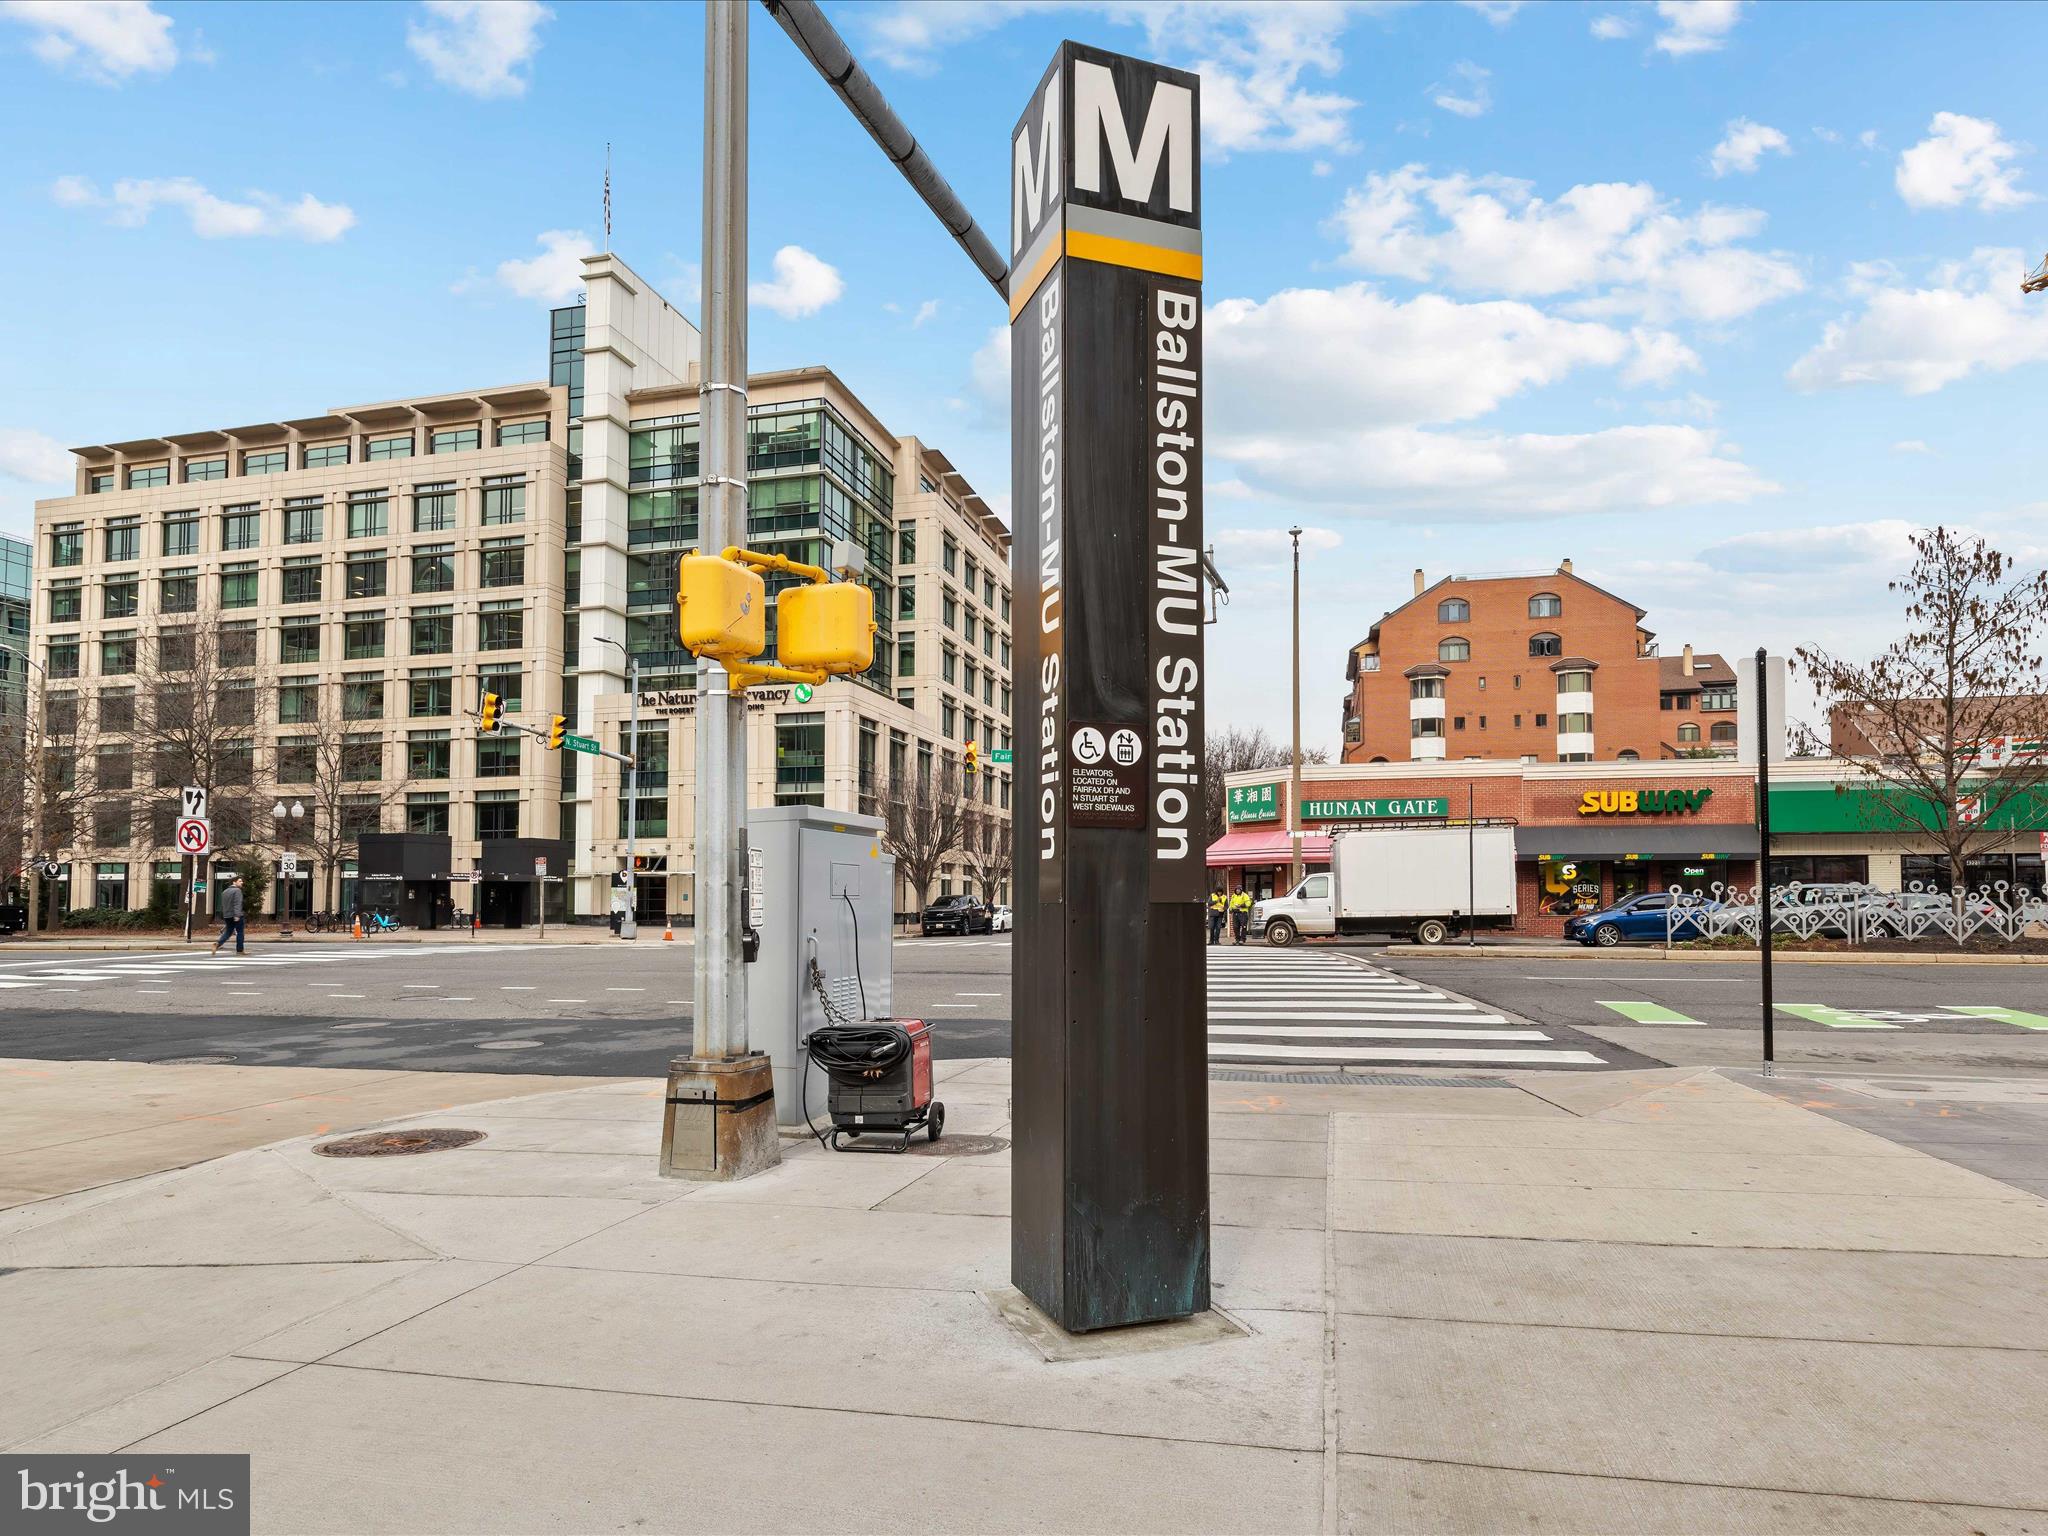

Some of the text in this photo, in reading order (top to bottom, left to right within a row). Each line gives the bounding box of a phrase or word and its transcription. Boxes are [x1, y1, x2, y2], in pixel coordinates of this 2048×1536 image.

[1074, 59, 1192, 213] M
[1013, 66, 1060, 258] M
[1041, 276, 1060, 859] Ballston-MU Station
[1156, 290, 1198, 859] Ballston-MU Station
[637, 692, 656, 707] The
[669, 707, 695, 715] ROBERT
[573, 740, 589, 750] Stuart
[1072, 768, 1114, 777] ELEVATORS
[1072, 777, 1105, 785] LOCATED
[1072, 785, 1102, 794] FAIRFAX
[1115, 787, 1130, 795] AND
[1080, 794, 1108, 802] STUART
[1577, 787, 1713, 814] SUBWAY
[1072, 802, 1135, 812] WEST SIDEWALKS
[1310, 800, 1439, 816] HUNAN GATE
[1240, 810, 1257, 820] Chinese
[1572, 884, 1599, 894] SERIES
